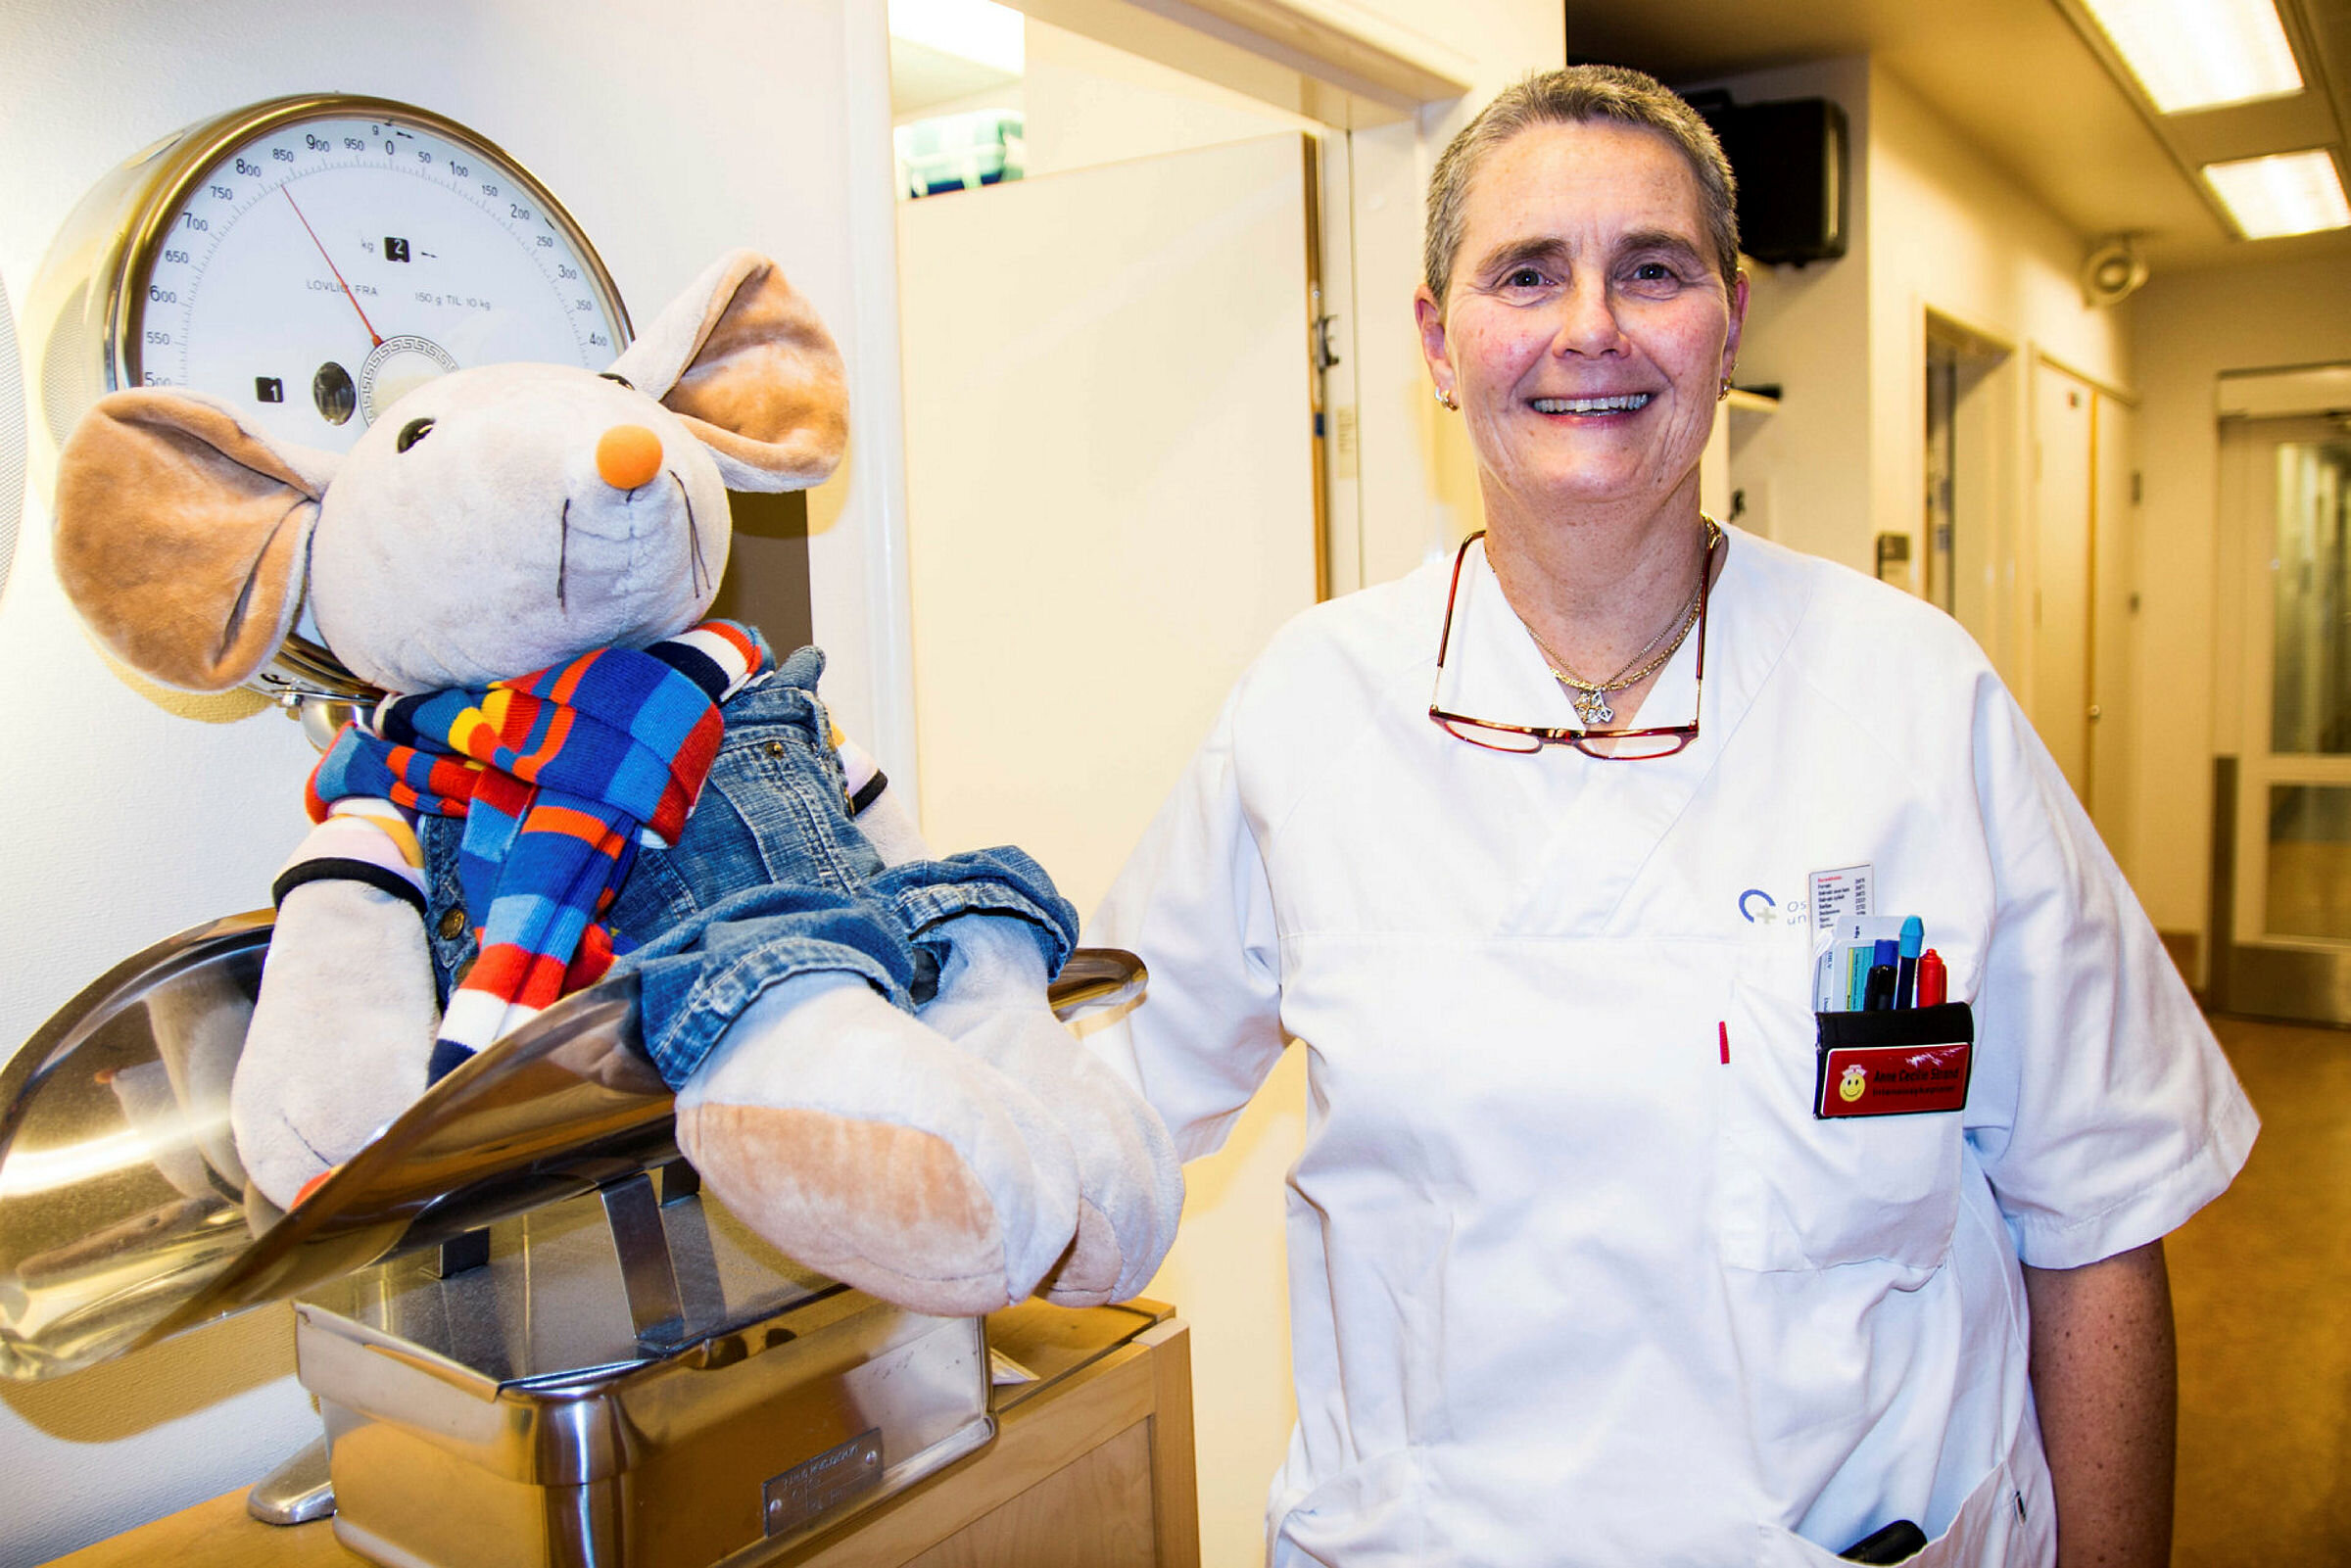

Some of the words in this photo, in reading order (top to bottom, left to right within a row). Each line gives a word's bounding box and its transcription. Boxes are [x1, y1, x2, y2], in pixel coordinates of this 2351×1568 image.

[306, 133, 330, 153] 900
[344, 137, 364, 152] 950
[385, 140, 395, 156] 0
[272, 148, 294, 163] 850
[417, 151, 431, 164] 50
[235, 158, 262, 177] 800
[450, 161, 469, 177] 100
[210, 185, 233, 201] 750
[481, 184, 499, 197] 150
[509, 203, 530, 220] 200
[182, 212, 208, 231] 700
[360, 237, 374, 253] kg
[536, 235, 553, 248] 250
[165, 250, 189, 263] 650
[557, 264, 577, 280] 300
[149, 285, 177, 304] 600
[355, 284, 379, 296] FRA
[414, 291, 432, 304] 150
[447, 295, 461, 306] TIL
[466, 298, 477, 308] 10
[479, 299, 492, 310] kg
[576, 300, 592, 311] 350
[146, 330, 170, 345] 550
[590, 331, 607, 347] 400
[144, 371, 172, 387] 500
